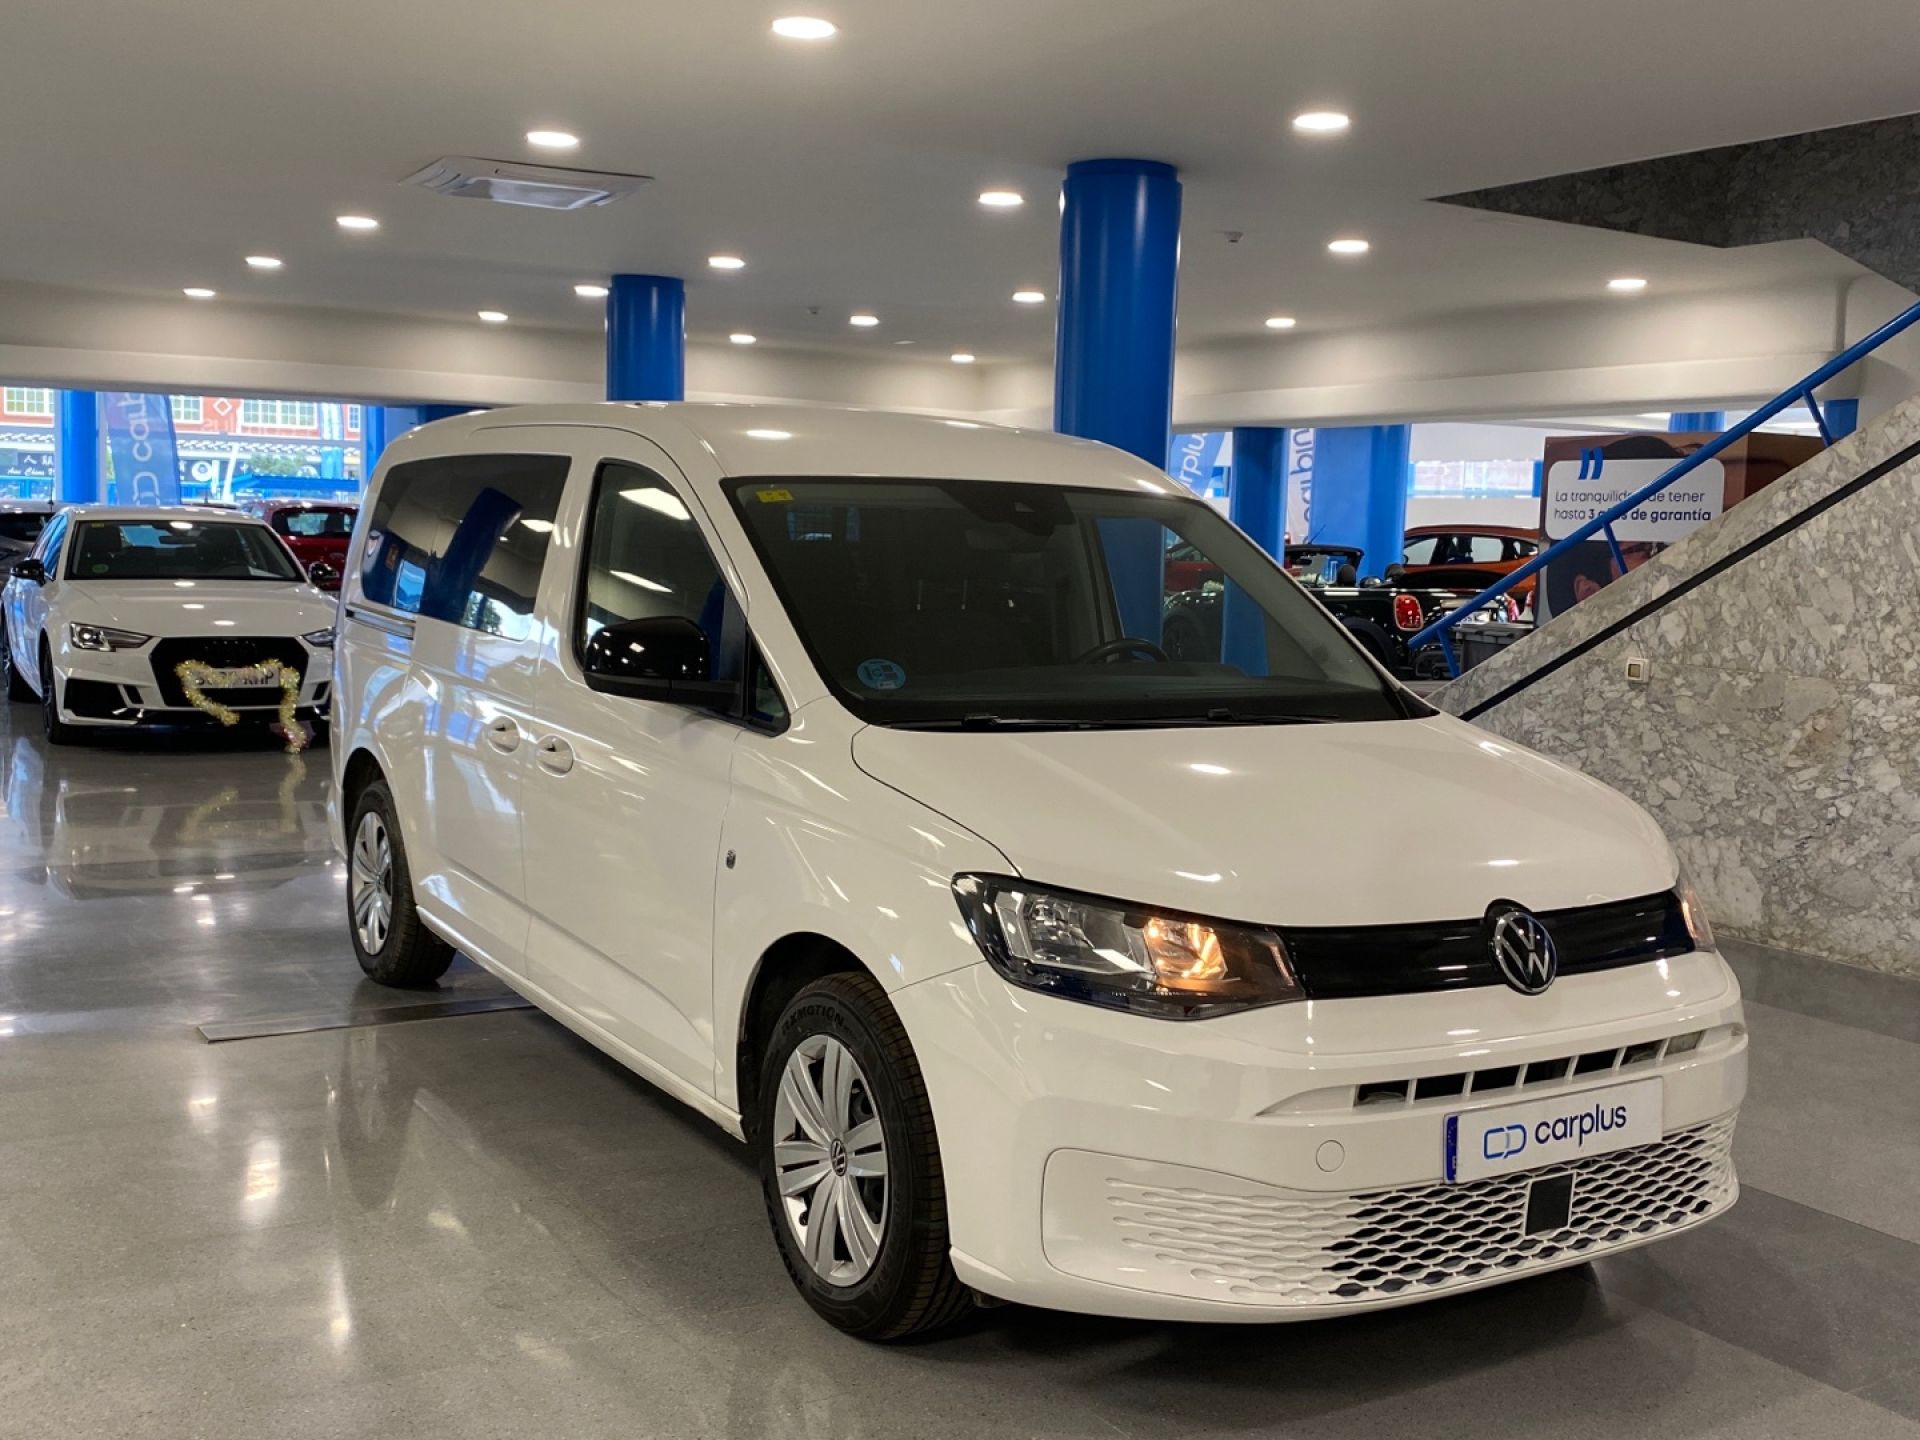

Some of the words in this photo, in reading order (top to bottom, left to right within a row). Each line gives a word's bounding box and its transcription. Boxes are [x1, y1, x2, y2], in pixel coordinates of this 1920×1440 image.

[1179, 433, 1208, 488] rplu
[1555, 491, 1568, 502] La
[1571, 490, 1637, 504] tranquilid
[1668, 492, 1705, 502] tener
[1554, 509, 1586, 520] hasta
[1587, 509, 1595, 520] 3
[1631, 508, 1647, 521] de
[1650, 508, 1711, 523] garantía
[1534, 1103, 1627, 1148] carplus
